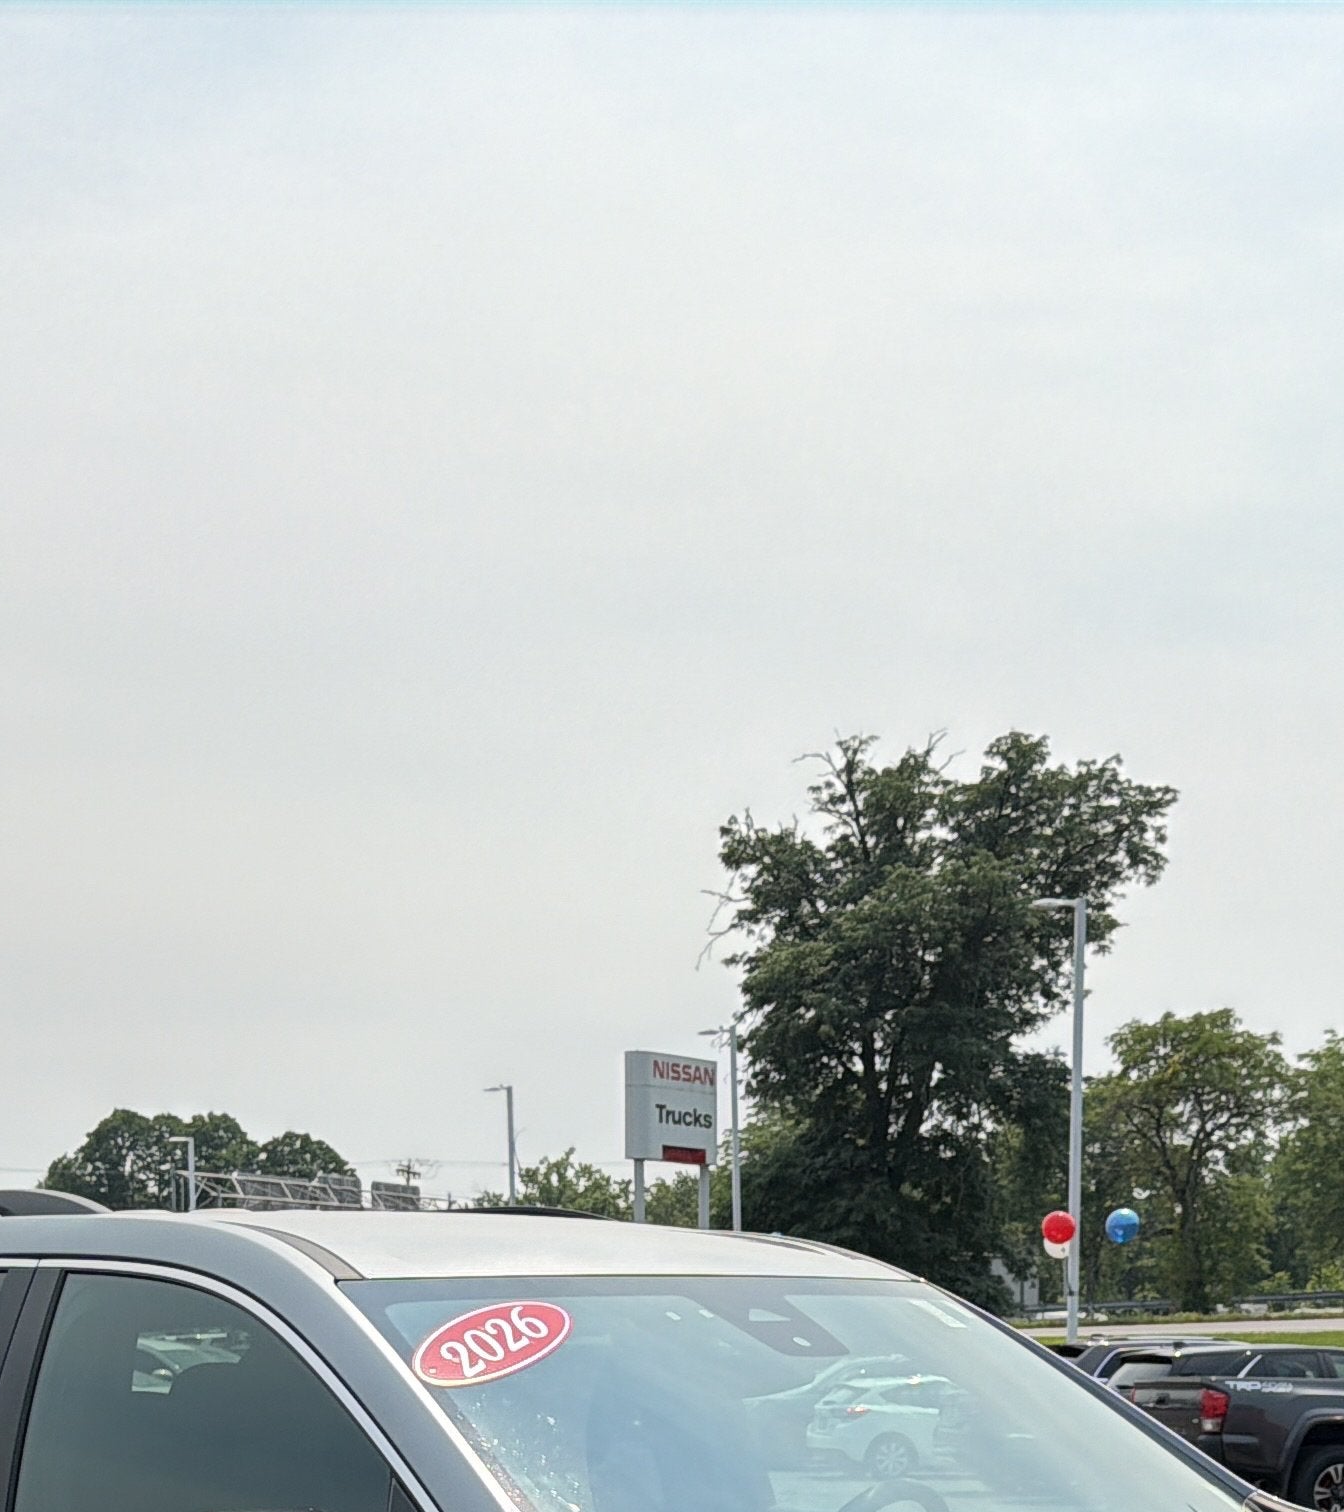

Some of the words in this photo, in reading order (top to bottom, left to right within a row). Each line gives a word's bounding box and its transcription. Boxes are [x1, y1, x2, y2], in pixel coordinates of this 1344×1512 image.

[652, 1059, 715, 1087] NISSAN
[655, 1103, 713, 1129] Trucks
[439, 1305, 549, 1378] 2026
